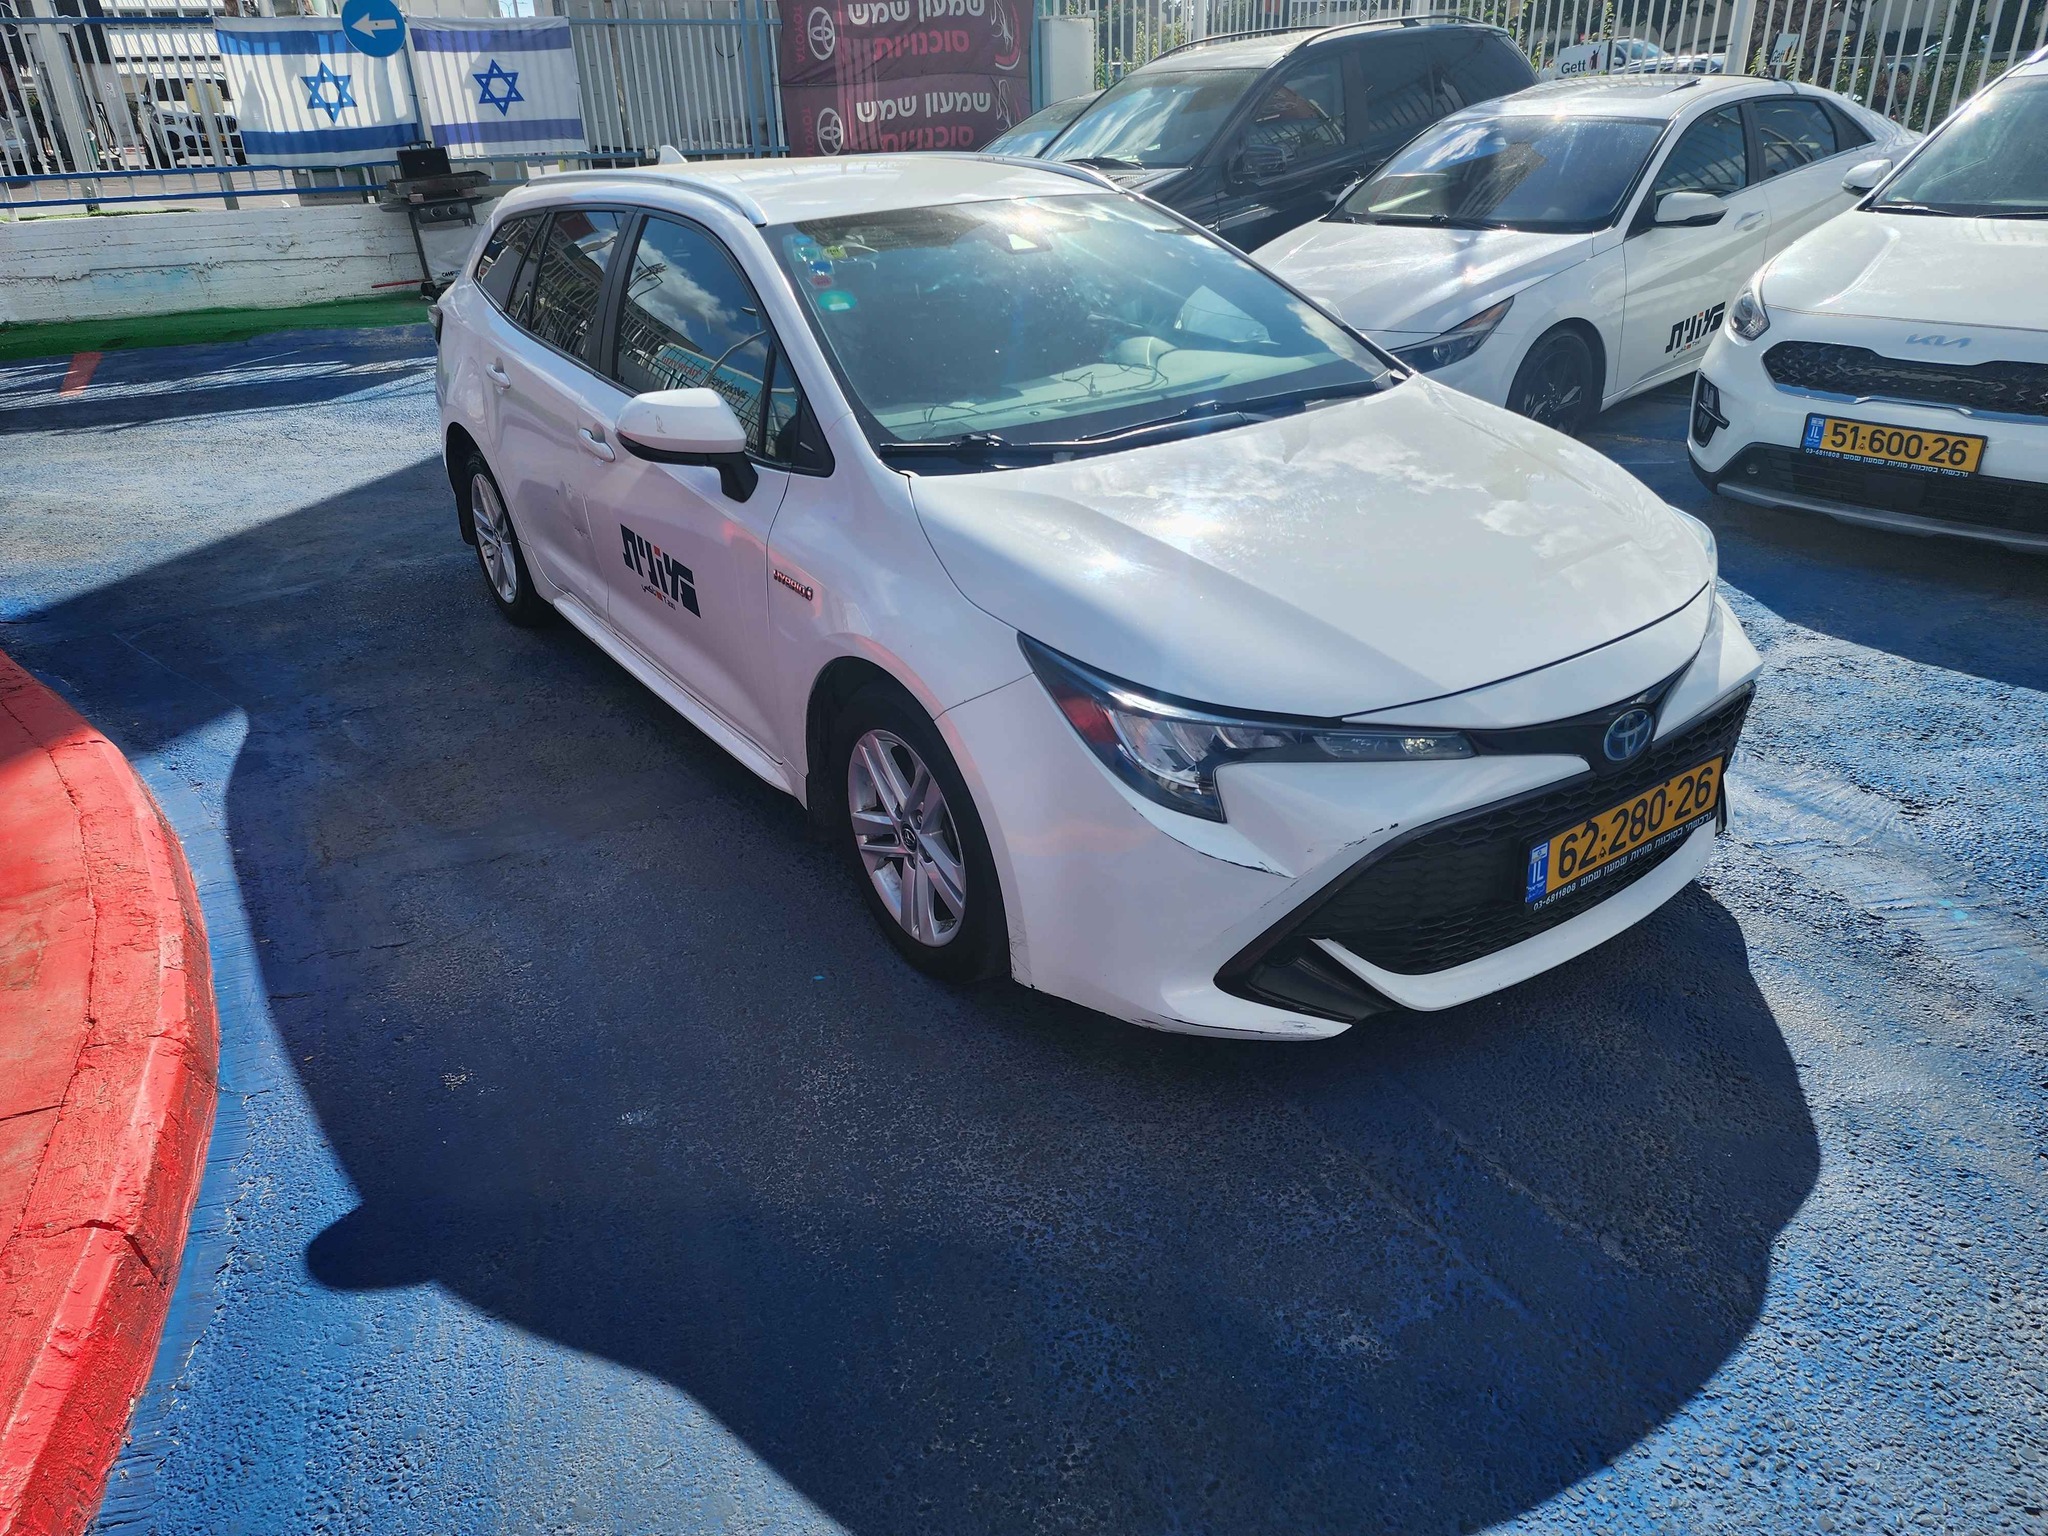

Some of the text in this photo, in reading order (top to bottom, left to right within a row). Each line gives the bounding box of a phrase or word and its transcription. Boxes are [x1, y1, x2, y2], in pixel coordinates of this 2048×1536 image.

[847, 0, 985, 25] שמעון שמש
[873, 29, 970, 61] סוכנויות
[1561, 60, 1586, 75] Gett
[856, 92, 991, 123] שמעון שמש
[1665, 302, 1725, 354] מונית
[1843, 454, 1861, 462] שמש
[1862, 456, 1885, 466] שמעון
[620, 523, 701, 618] מונית
[1630, 843, 1653, 861] מוניות
[1532, 860, 1544, 884] IL
[1603, 855, 1628, 876] שמעון
[1580, 869, 1602, 887] שמש
[1533, 882, 1577, 911] 03-6811808
